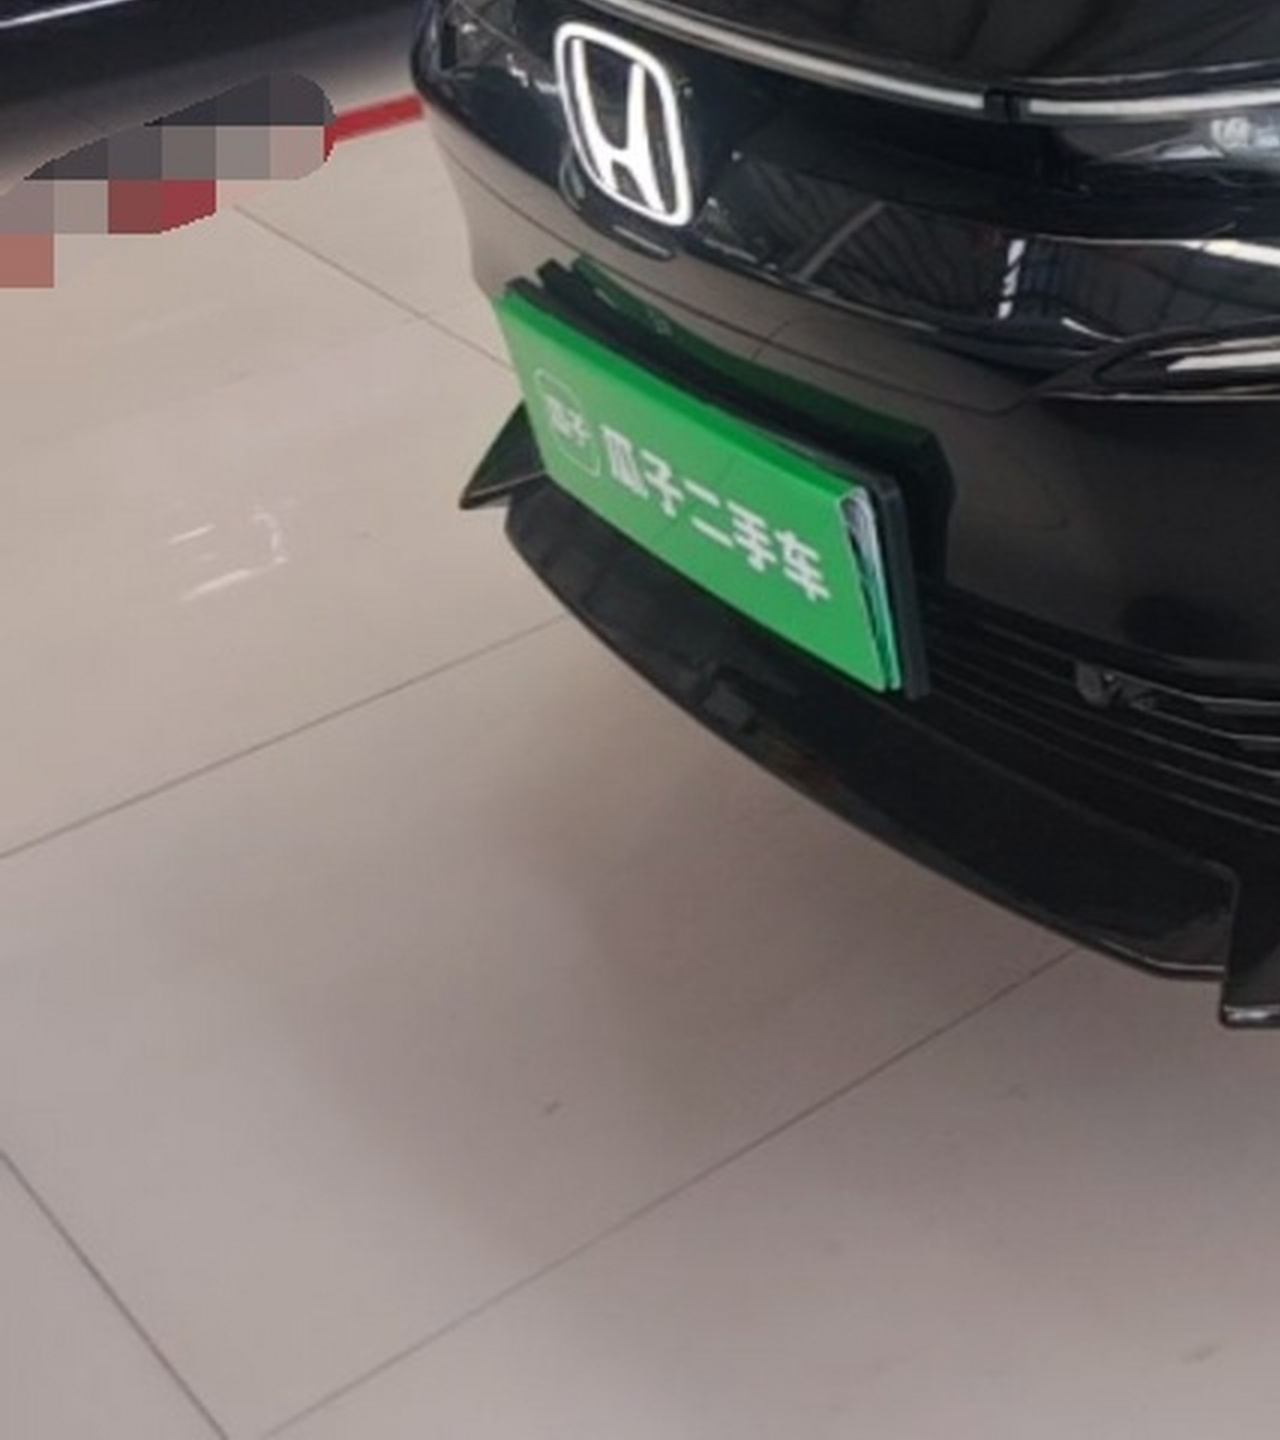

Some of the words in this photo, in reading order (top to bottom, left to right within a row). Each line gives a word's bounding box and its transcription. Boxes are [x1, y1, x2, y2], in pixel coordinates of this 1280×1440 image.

[599, 423, 831, 602] 瓜子二手车
